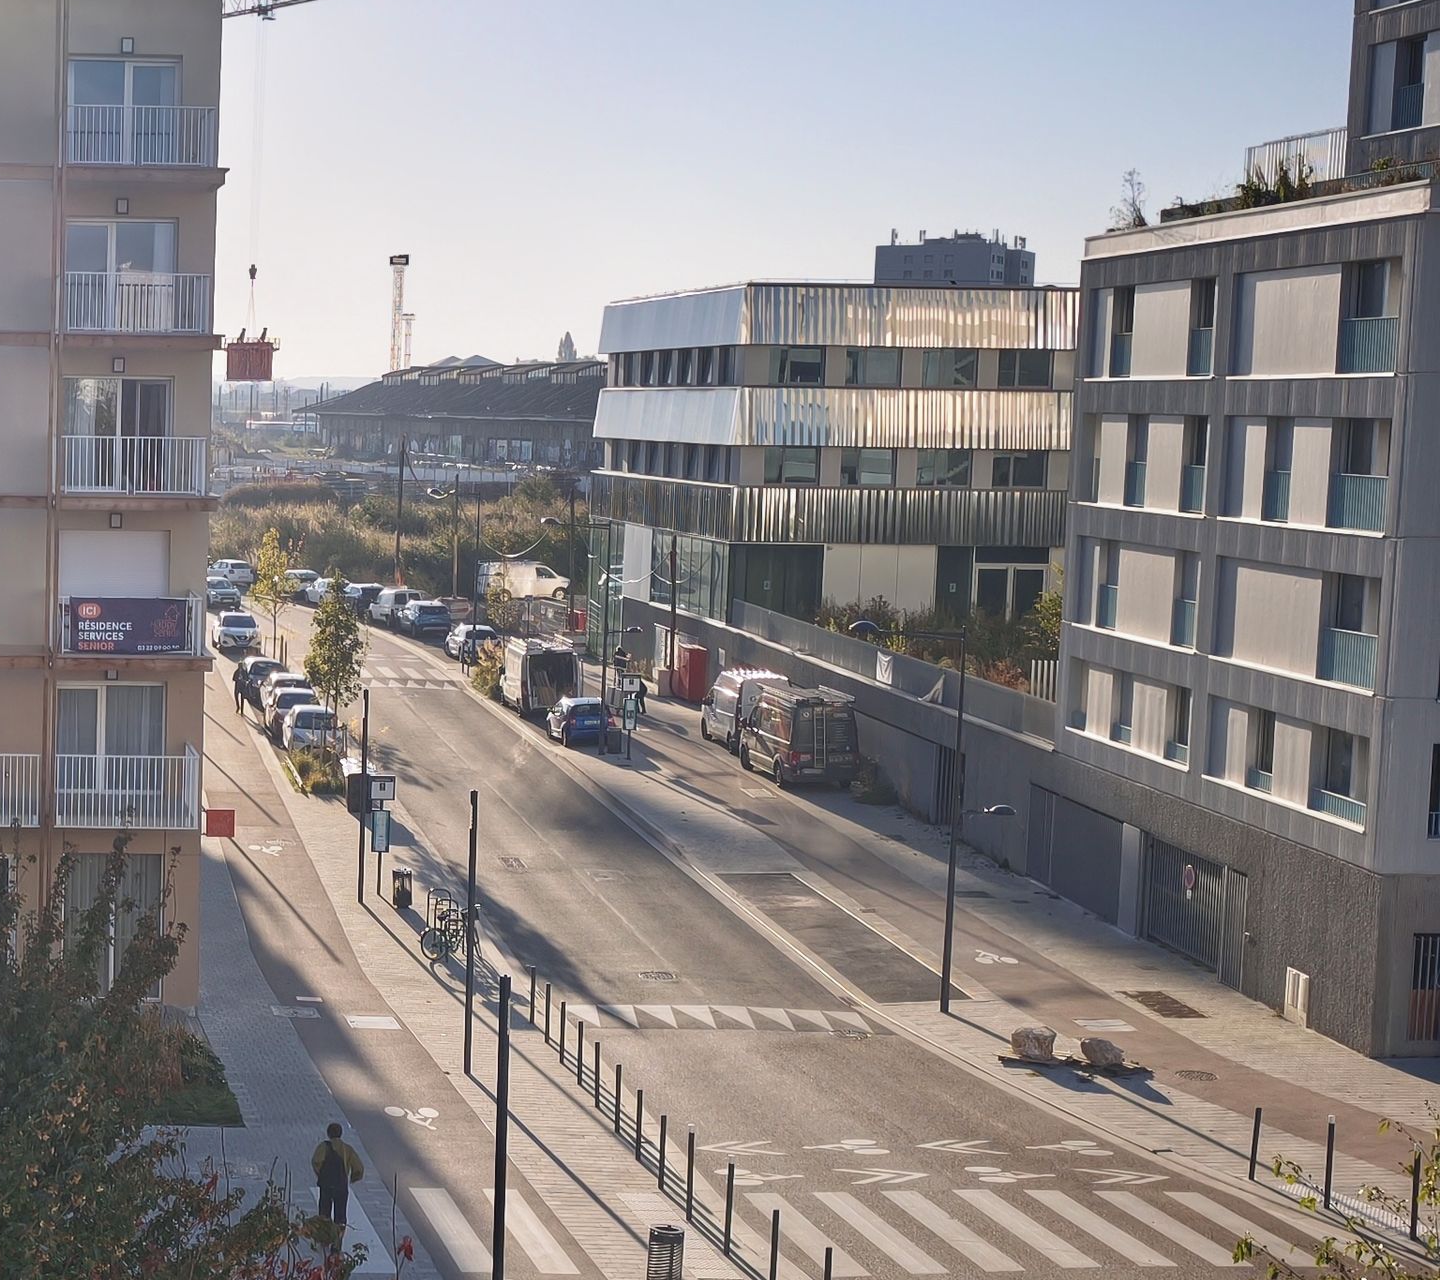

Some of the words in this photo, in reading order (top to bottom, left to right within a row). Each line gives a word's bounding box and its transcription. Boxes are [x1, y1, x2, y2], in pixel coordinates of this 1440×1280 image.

[82, 606, 97, 615] ICI
[78, 620, 133, 631] RÉSIDENCE
[78, 632, 124, 640] SERVICES
[78, 642, 114, 650] SENIOR
